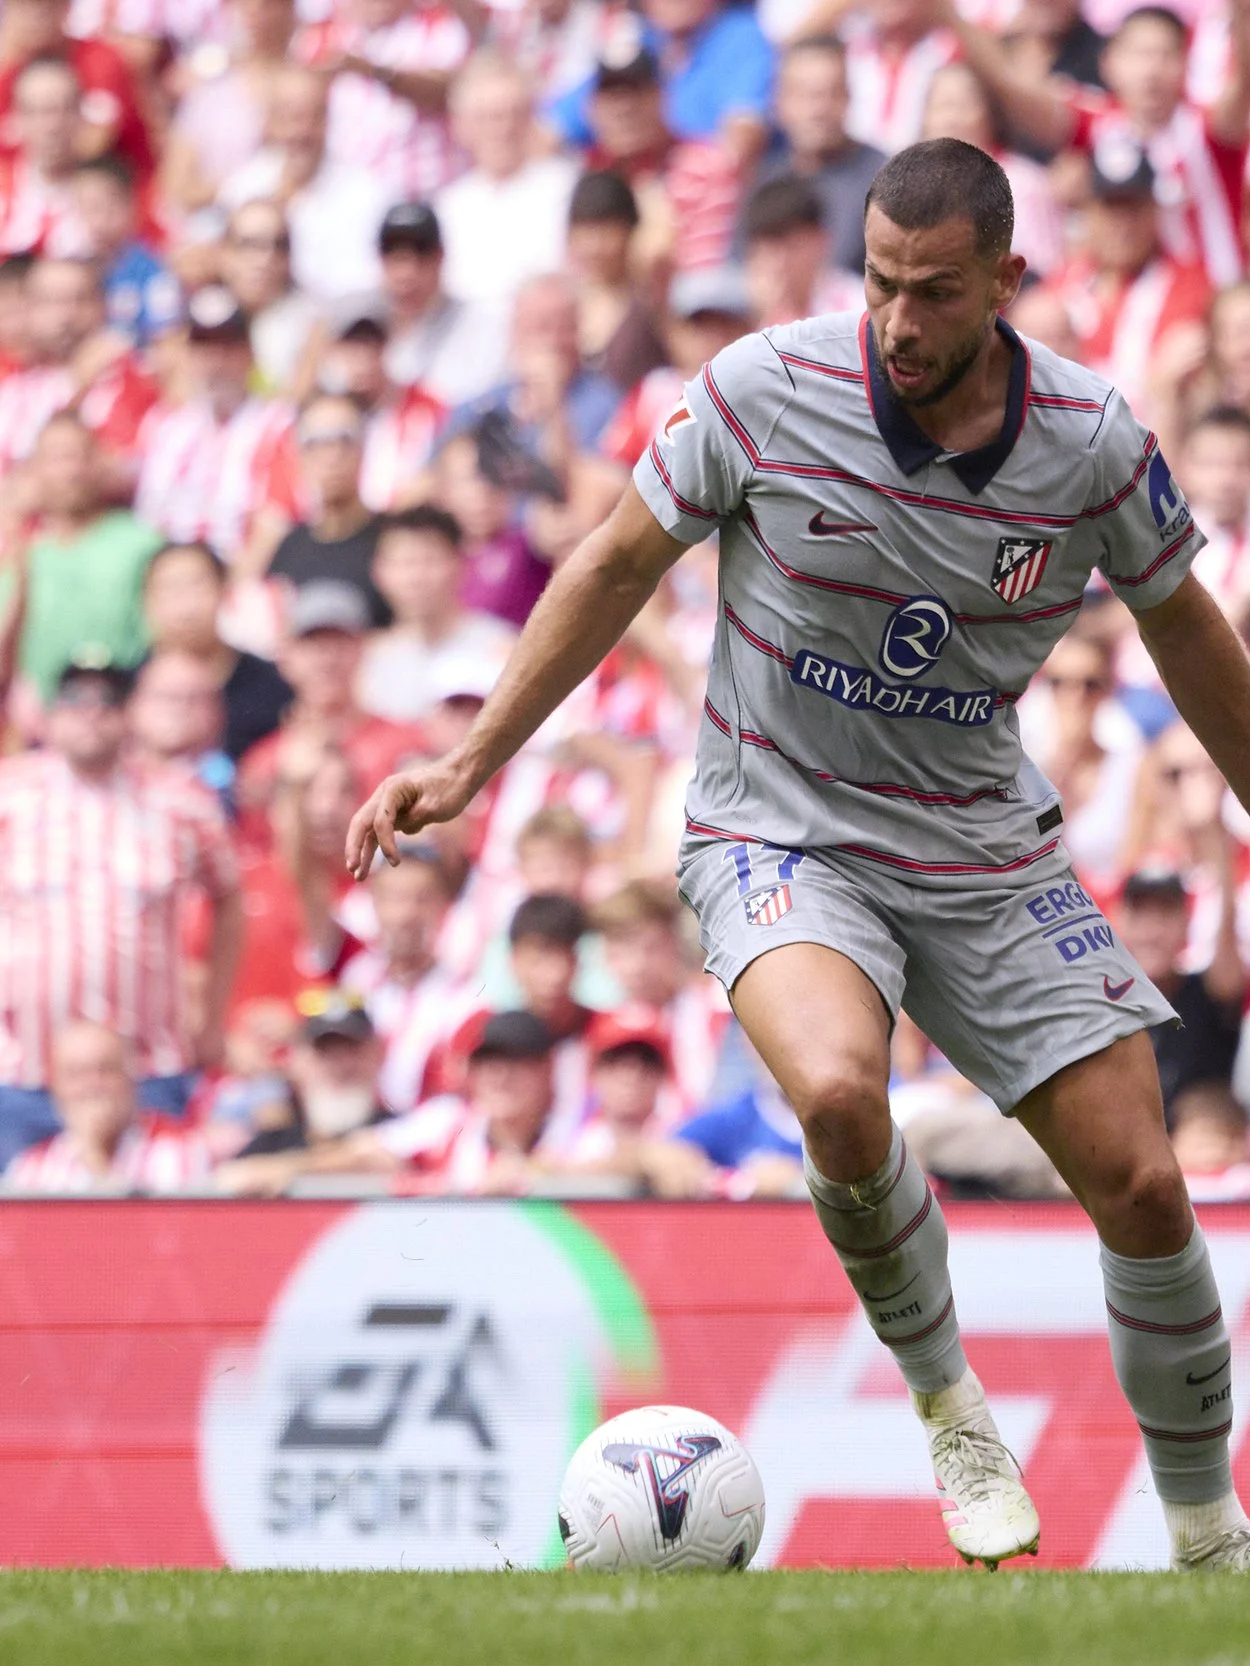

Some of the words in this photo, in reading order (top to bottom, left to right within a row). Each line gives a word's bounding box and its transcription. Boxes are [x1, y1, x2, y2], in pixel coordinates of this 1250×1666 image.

[800, 655, 930, 713] RIYADH
[930, 695, 991, 723] AIR
[720, 841, 807, 898] 17
[1055, 925, 1115, 963] DKV
[878, 1301, 922, 1323] ATLETI
[277, 1303, 502, 1449] EA
[265, 1467, 509, 1533] SPORTS
